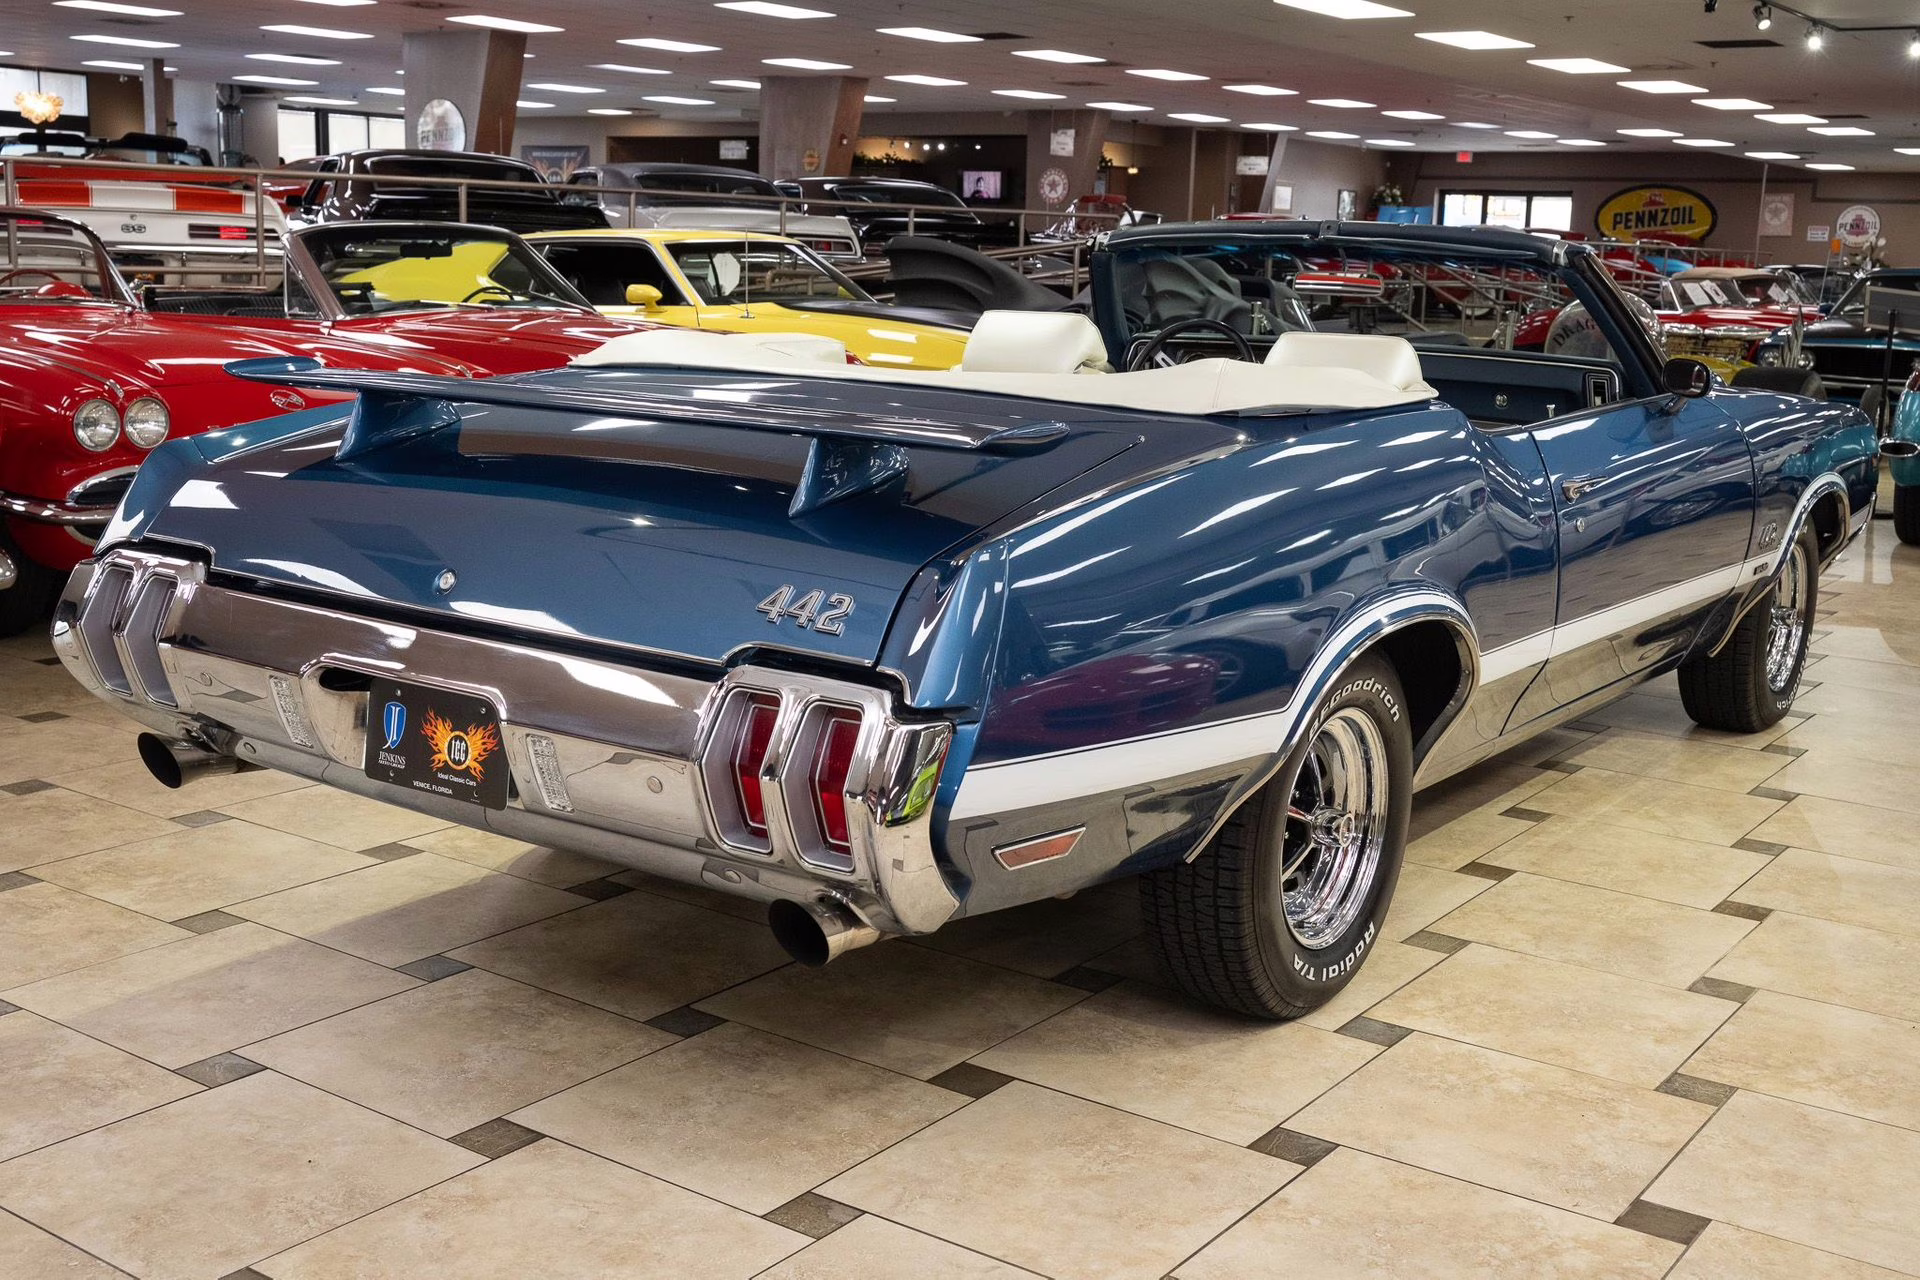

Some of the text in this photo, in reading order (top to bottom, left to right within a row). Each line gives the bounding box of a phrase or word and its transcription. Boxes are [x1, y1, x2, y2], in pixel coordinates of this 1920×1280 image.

[1611, 206, 1697, 231] PENNZOIL
[1838, 221, 1878, 231] PENNZOIL
[121, 224, 147, 233] SS
[755, 584, 855, 637] 442
[1309, 678, 1400, 741] BFGoodrich
[378, 751, 406, 765] JENKINS
[437, 772, 477, 787] Ideal Classic Cars
[413, 780, 453, 795] VENICE, FLORIDA
[1293, 921, 1375, 982] Radial T/A
